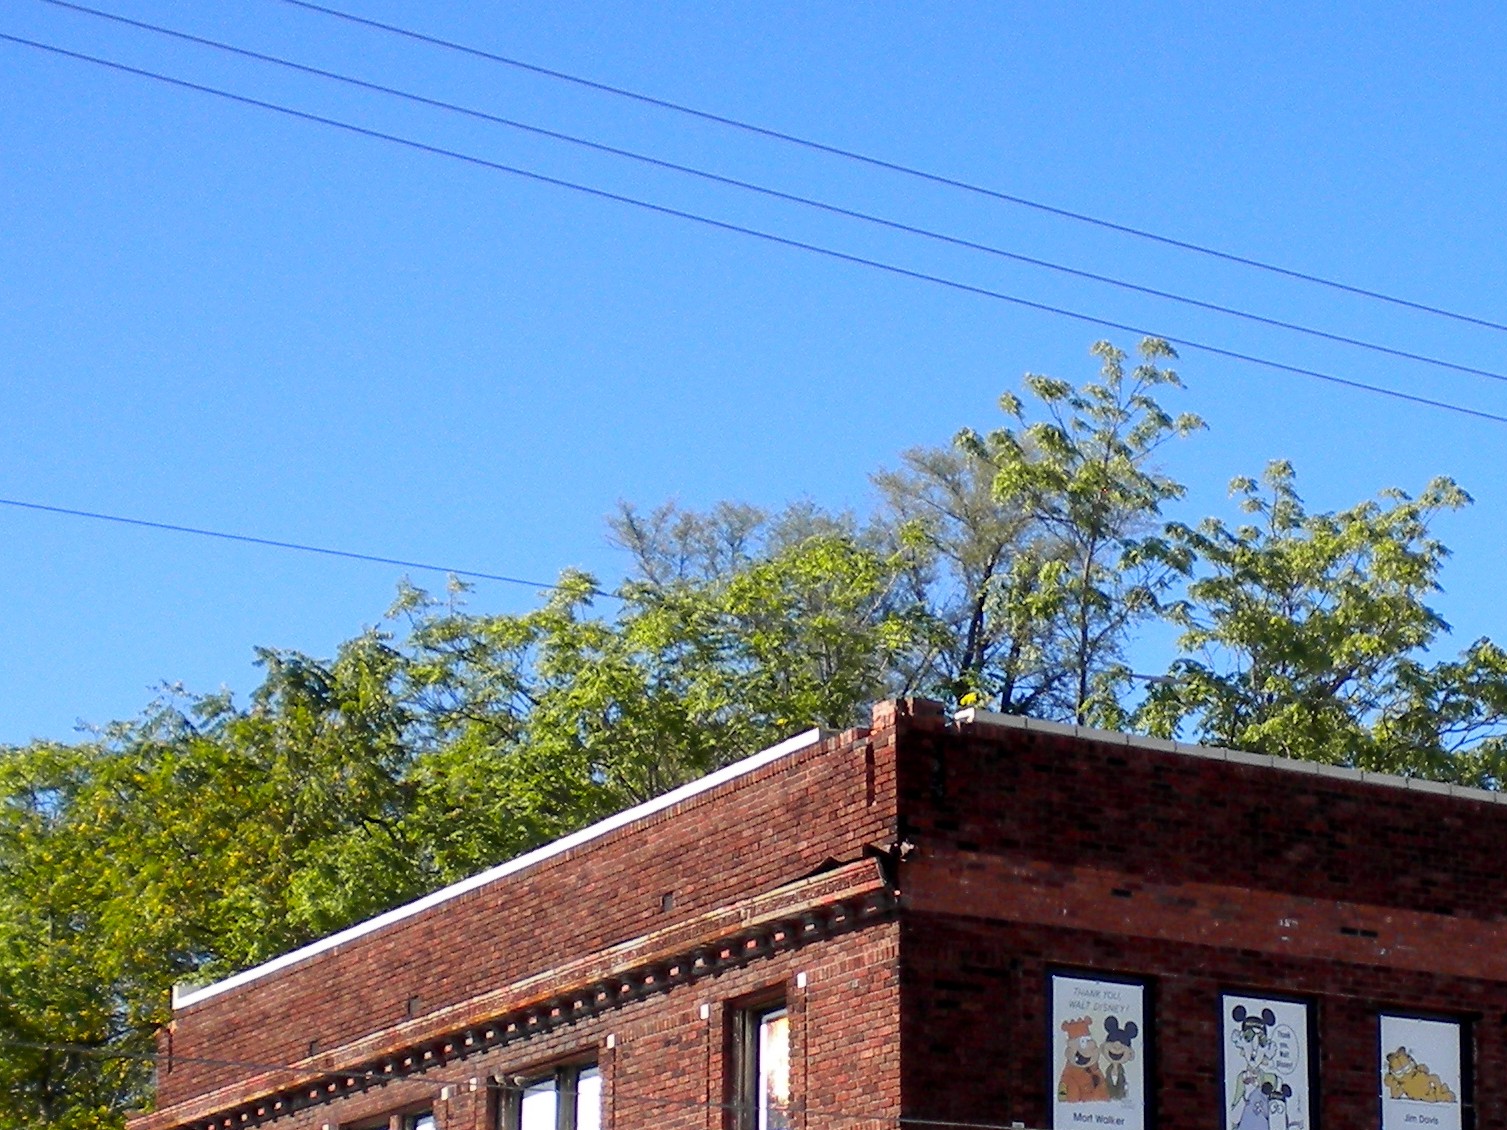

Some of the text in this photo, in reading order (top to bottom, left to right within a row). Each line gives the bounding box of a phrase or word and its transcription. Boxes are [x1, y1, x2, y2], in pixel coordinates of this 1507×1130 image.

[1069, 1000, 1091, 1010] WALT
[1073, 1112, 1125, 1126] Mort Walker
[1419, 1114, 1439, 1125] Davis
